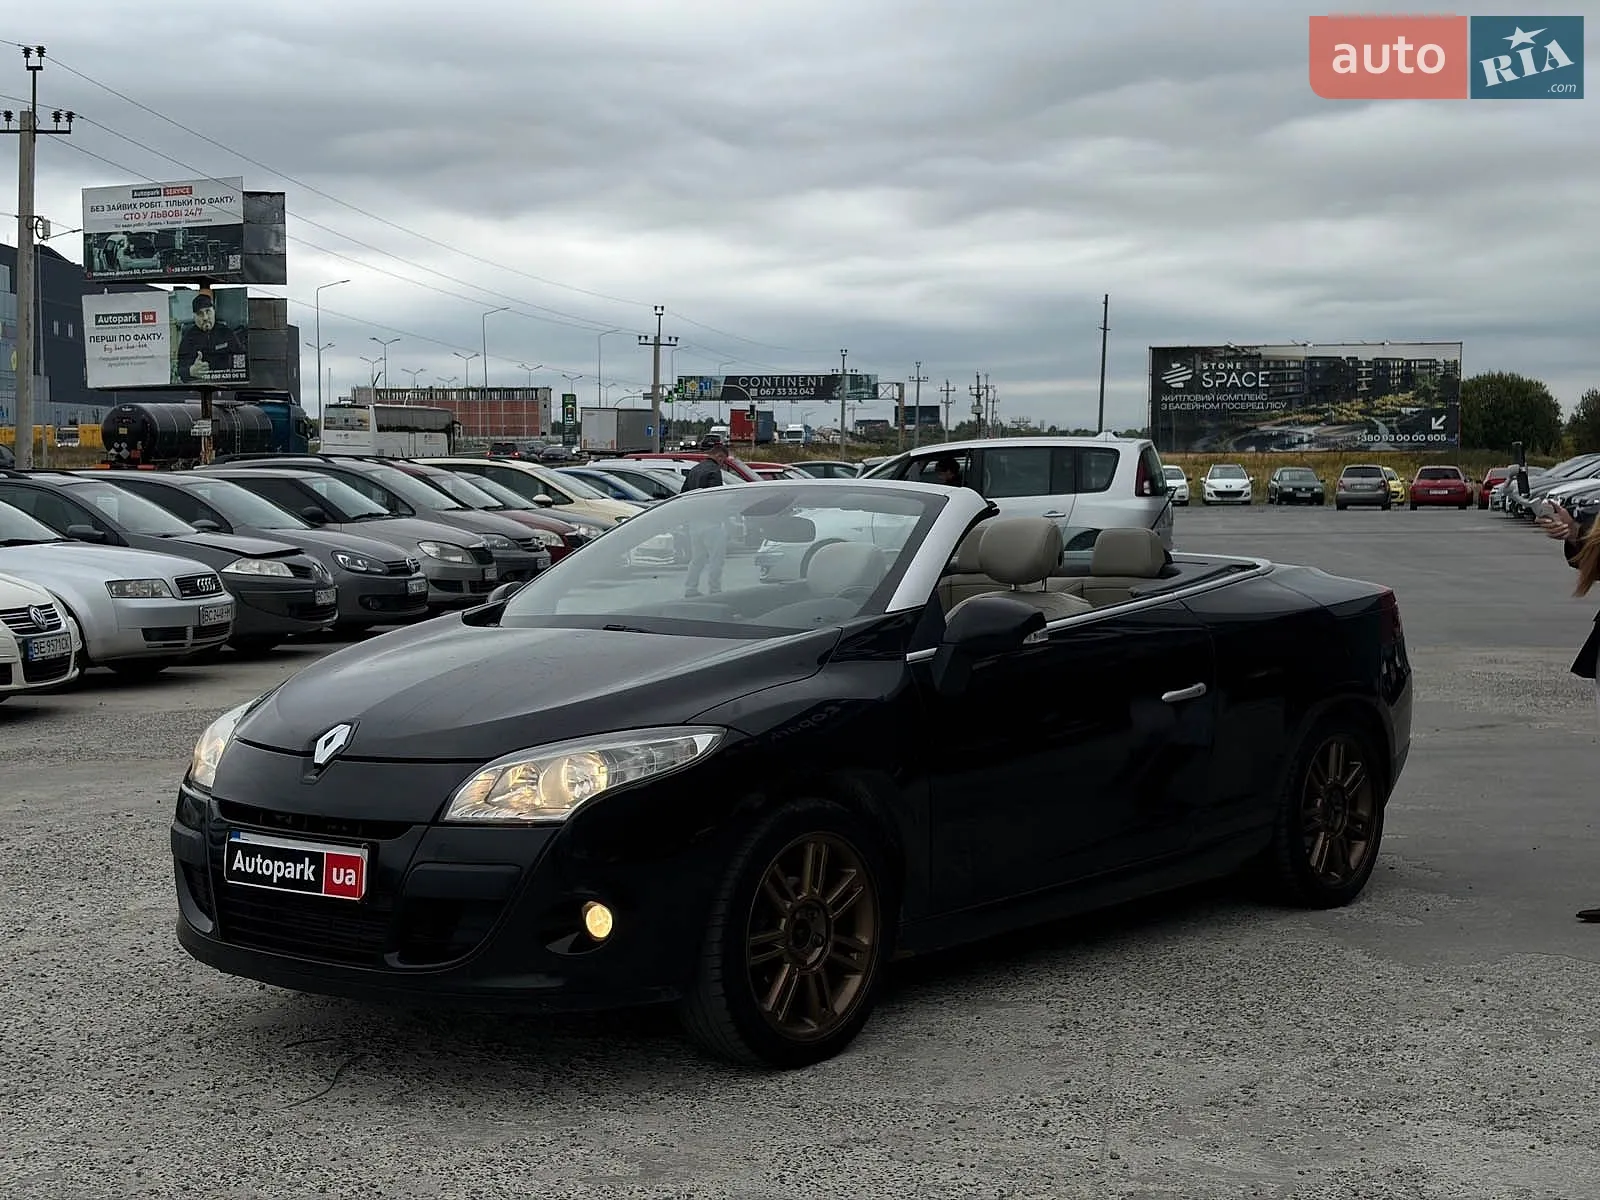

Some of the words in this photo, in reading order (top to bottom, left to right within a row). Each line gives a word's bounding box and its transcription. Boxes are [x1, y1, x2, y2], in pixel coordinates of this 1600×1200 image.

[90, 205, 105, 213] БЕЗ
[106, 202, 138, 212] ЗАЙВИХ
[166, 198, 193, 207] ТІЛЬКИ
[123, 212, 140, 221] СТО
[142, 211, 148, 220] У
[150, 209, 183, 219] ЛЬВОВІ
[184, 207, 203, 217] 24/7
[98, 313, 137, 324] Autopark
[89, 335, 117, 343] ПЕРШІ
[118, 334, 132, 342] ПО
[132, 332, 164, 342] ФАКТУ.
[1202, 362, 1242, 370] STONE
[738, 376, 825, 388] CONTINENT
[1202, 371, 1270, 388] SPACE
[760, 387, 775, 396] 067
[1161, 393, 1215, 402] ЖИТЛОВИЙ
[1216, 393, 1268, 401] КОМПЛЕКС
[1161, 402, 1168, 410] З
[1168, 401, 1220, 410] БАСЕЙНОМ
[1221, 402, 1264, 410] ПОСЕРЕД
[1265, 401, 1288, 410] ЛІСУ
[1396, 433, 1410, 442] 00
[232, 849, 316, 884] Autopark
[331, 866, 357, 886] ua
